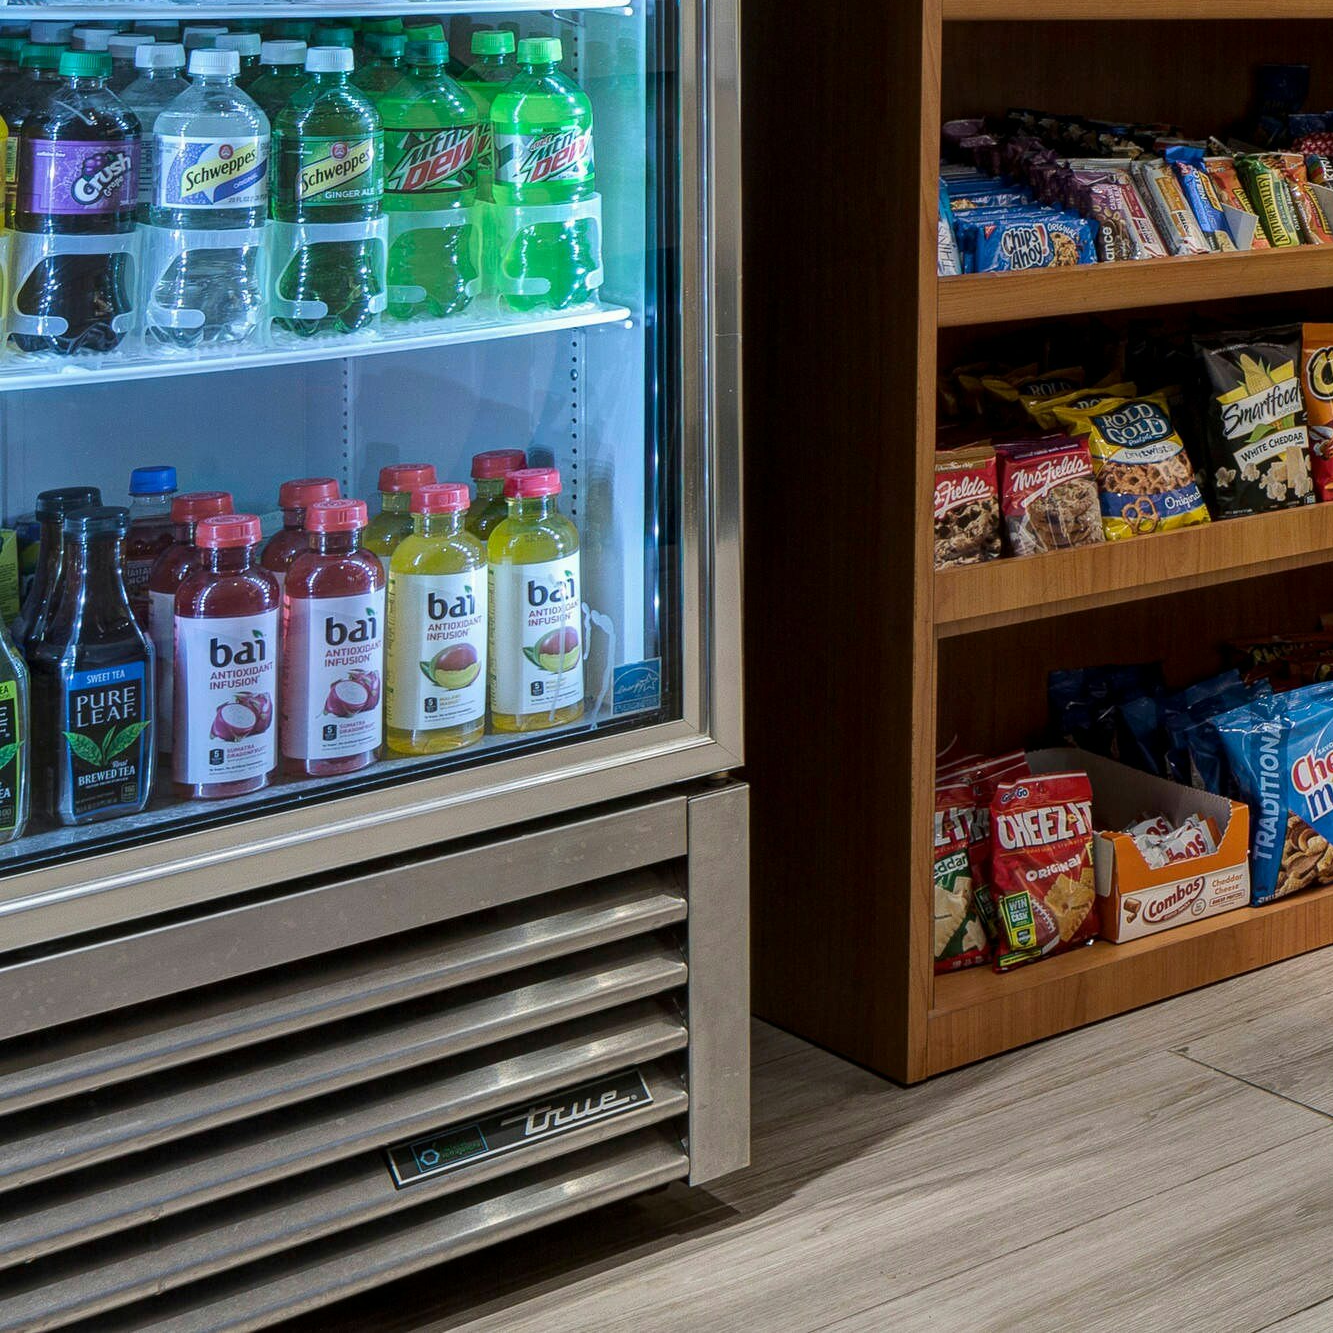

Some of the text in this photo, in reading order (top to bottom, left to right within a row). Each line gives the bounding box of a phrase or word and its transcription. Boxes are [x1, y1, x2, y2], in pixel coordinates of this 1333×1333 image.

[72, 152, 132, 204] Crush
[185, 148, 257, 191] Schweppes
[301, 148, 371, 193] Schweppes
[103, 175, 125, 198] Grape
[325, 187, 375, 199] GINGER ALE
[1002, 226, 1040, 256] Chips
[1102, 403, 1161, 429] ROLD
[1222, 378, 1300, 437] Smartfood
[1106, 417, 1169, 445] GOLD
[1240, 431, 1304, 463] WHITE CHEDDAR
[1040, 455, 1089, 492] Fields
[1164, 489, 1202, 512] Original
[427, 589, 476, 621] bai
[527, 577, 575, 608] bai
[325, 614, 378, 647] bai
[426, 628, 470, 642] INFUSION
[428, 615, 482, 633] ANTIOXIDANT
[209, 635, 266, 669] bai
[324, 639, 382, 659] ANTIOXIDANT
[324, 654, 370, 668] INFUSION
[86, 669, 126, 685] SWEET TEA
[209, 675, 260, 691] INFUSION
[210, 660, 273, 681] ANTIOXIDANT
[76, 686, 137, 712] PURE
[76, 703, 136, 728] LEAF
[78, 765, 136, 787] BREWED TEA
[1211, 873, 1244, 888] Cheddar
[1008, 898, 1027, 913] WIN
[1148, 877, 1201, 919] Combos
